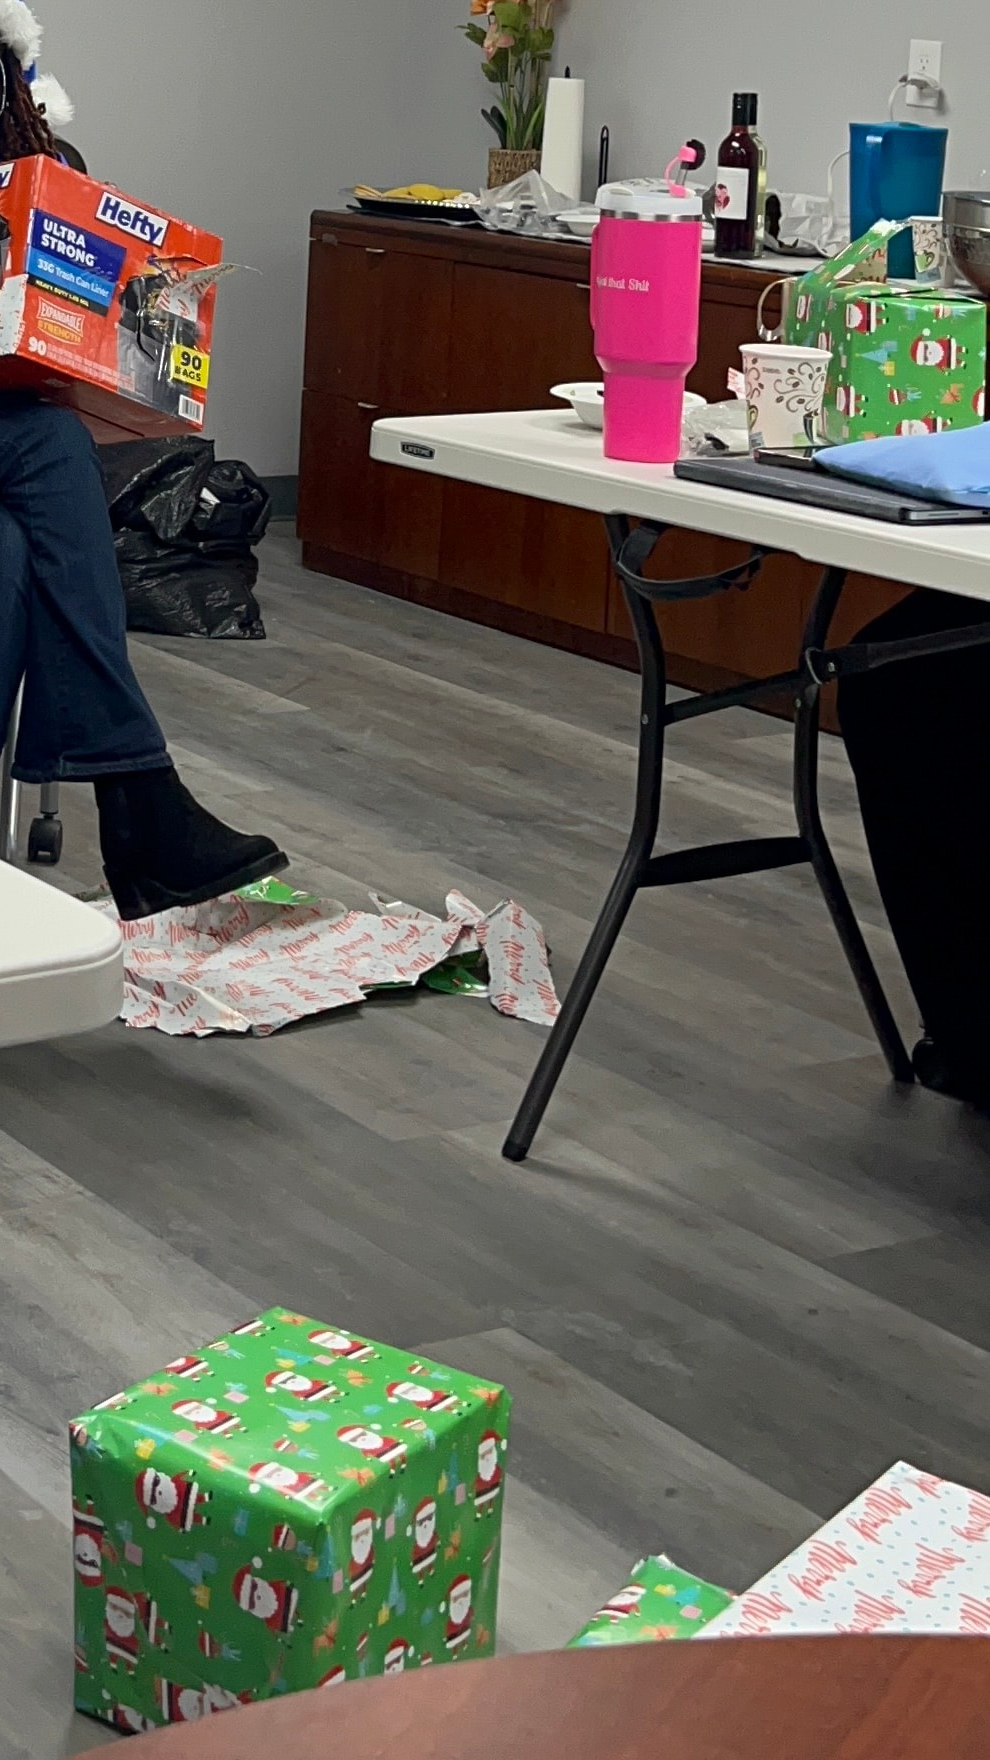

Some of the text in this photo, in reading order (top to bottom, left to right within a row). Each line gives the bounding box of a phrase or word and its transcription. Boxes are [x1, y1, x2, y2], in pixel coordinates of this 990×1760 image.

[43, 218, 86, 249] ULTRA
[100, 196, 164, 243] Hefty
[41, 234, 95, 268] STRONG
[37, 258, 110, 298] 33G Trash Can Liner
[39, 302, 83, 332] EXPANDABLE
[28, 335, 48, 357] 90
[180, 350, 202, 371] 90
[846, 1486, 913, 1545] Merry
[787, 1539, 858, 1602] Merry
[896, 1542, 966, 1598] Merry
